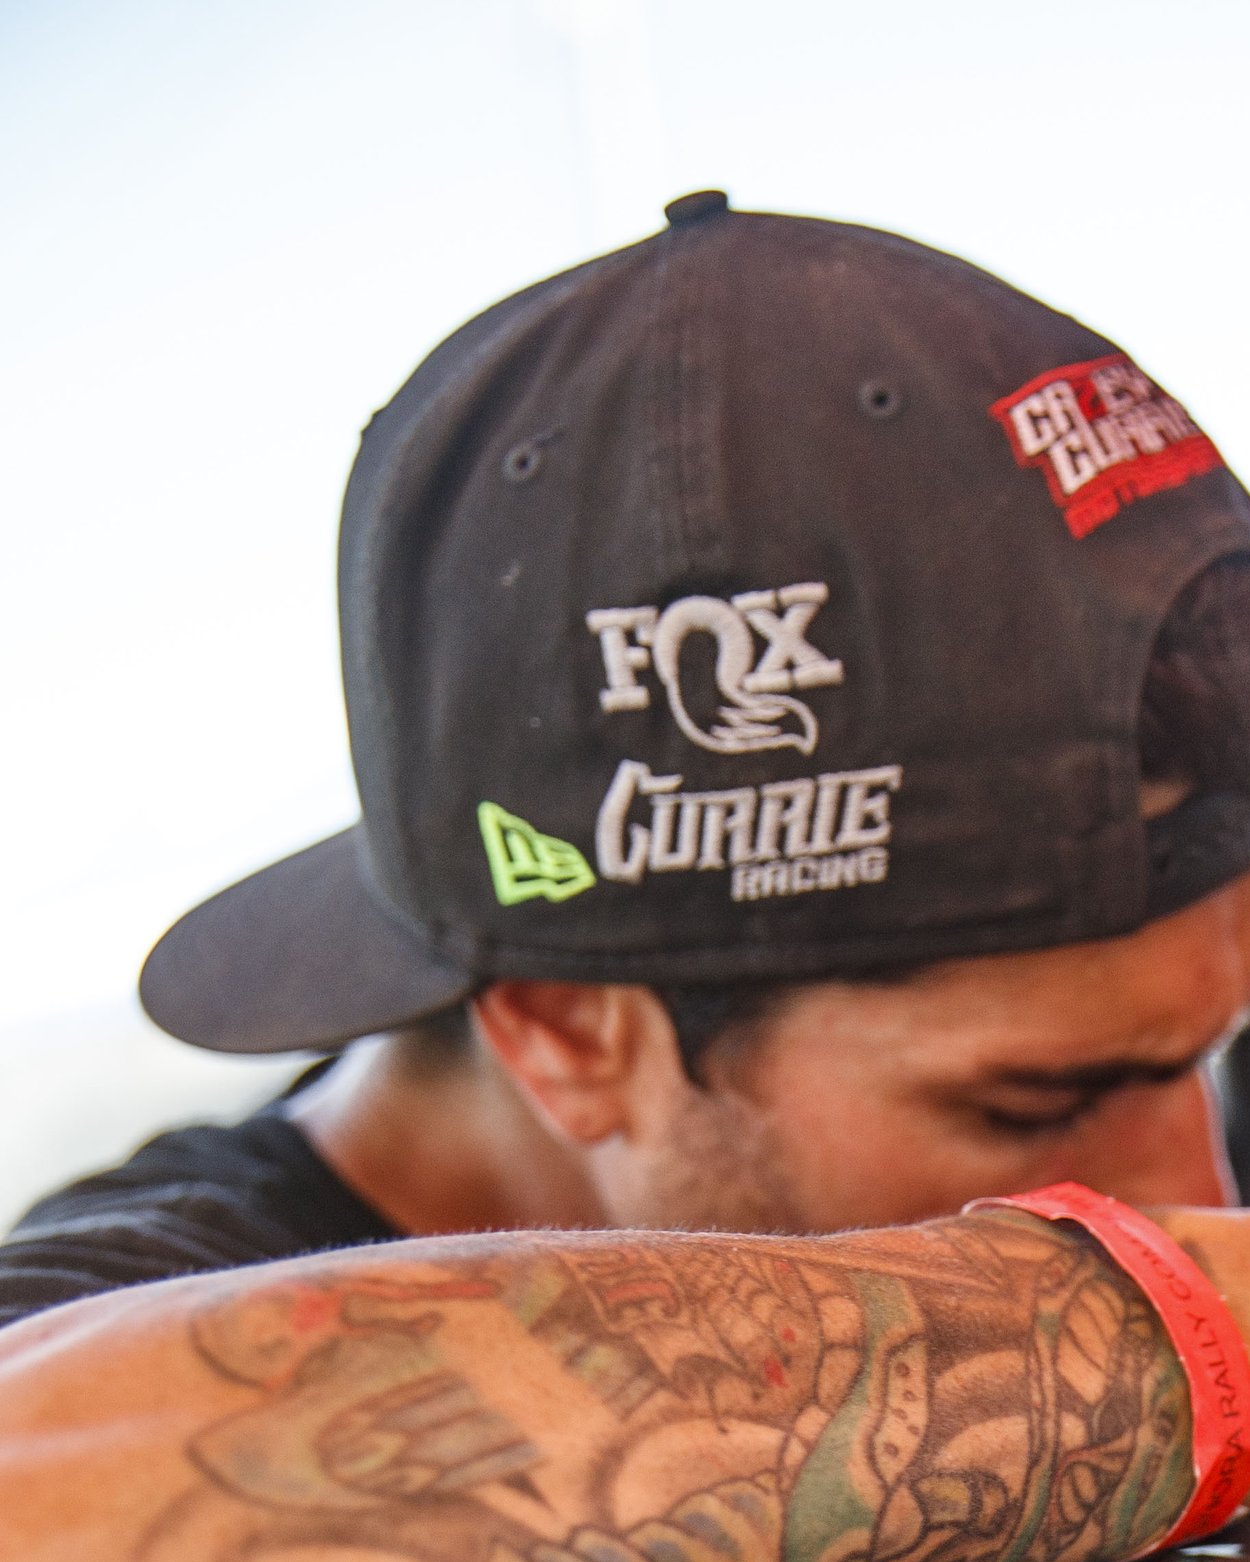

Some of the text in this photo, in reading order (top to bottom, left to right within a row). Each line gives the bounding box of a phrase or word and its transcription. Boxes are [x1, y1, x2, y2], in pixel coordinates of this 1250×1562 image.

[585, 582, 844, 755] FOX
[595, 758, 902, 886] CURRIE
[730, 846, 888, 901] RACING
[1187, 1310, 1239, 1419] RALLY
